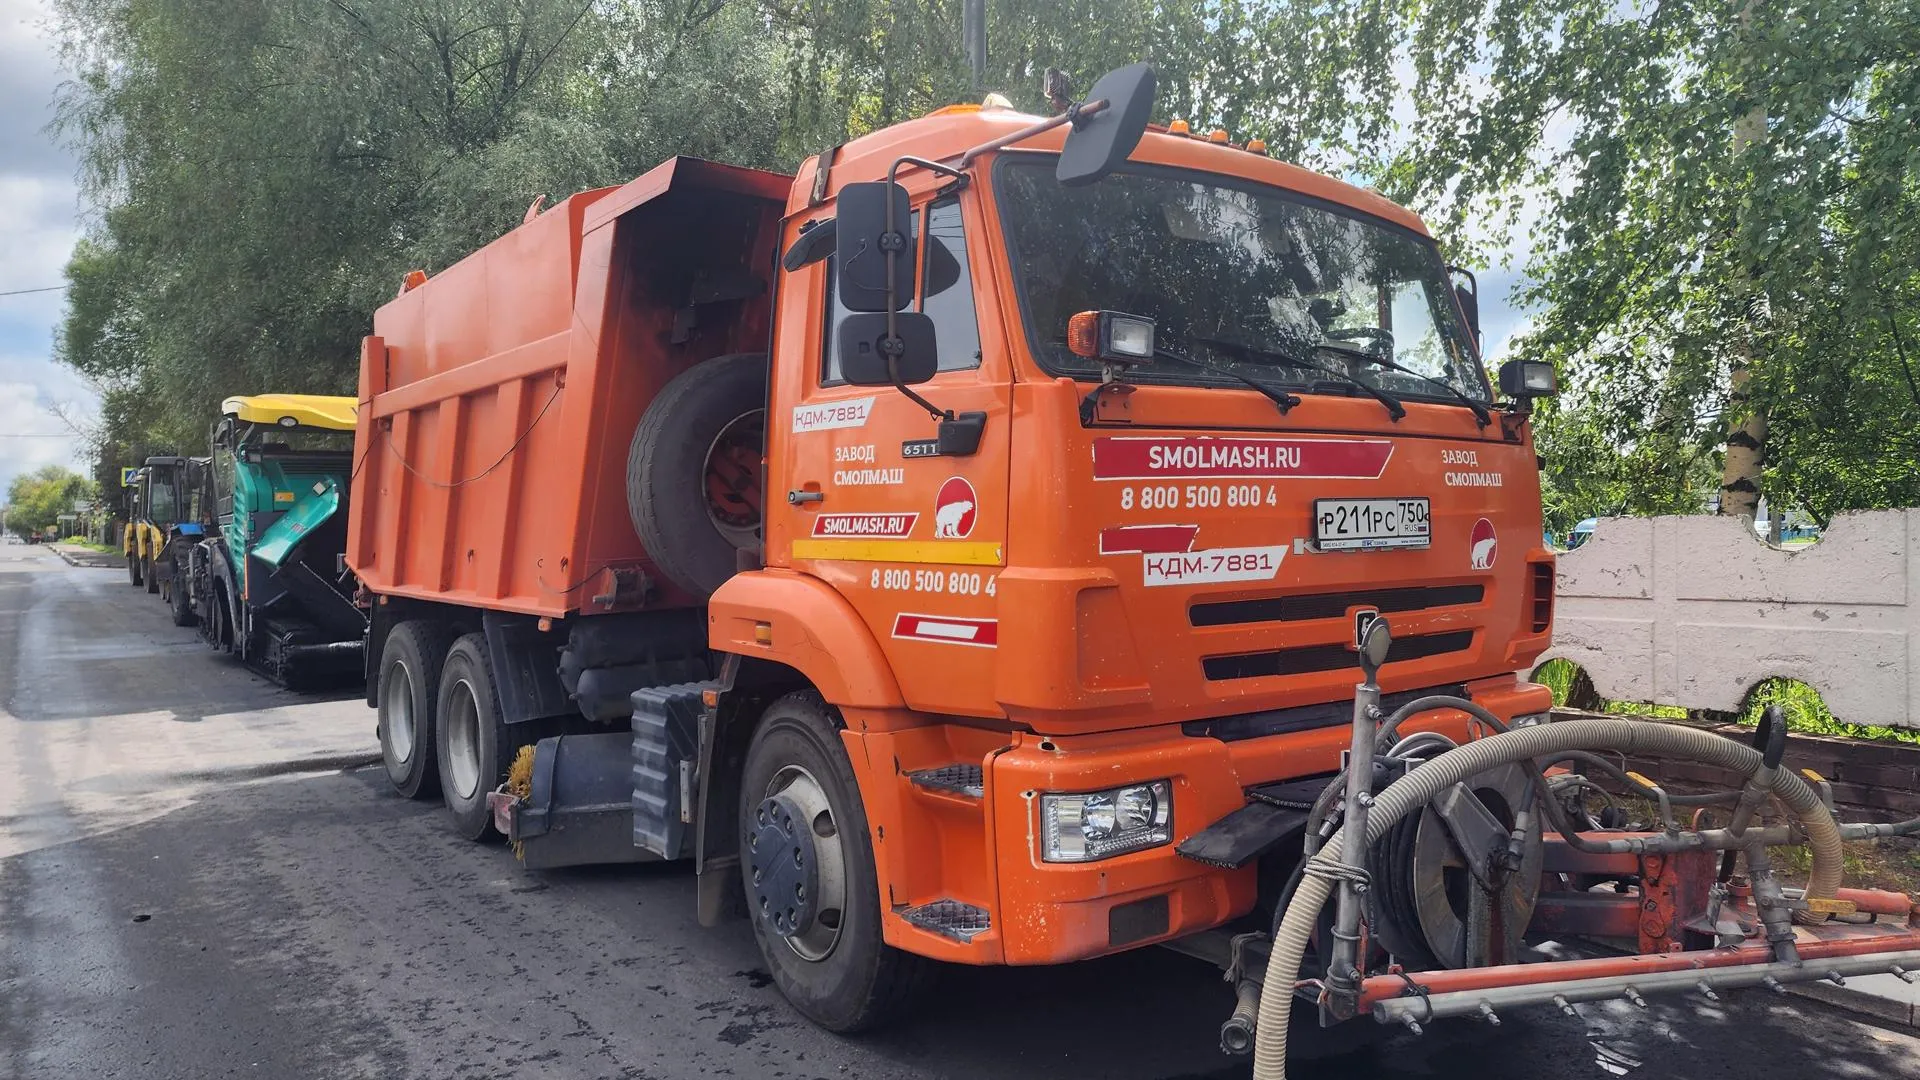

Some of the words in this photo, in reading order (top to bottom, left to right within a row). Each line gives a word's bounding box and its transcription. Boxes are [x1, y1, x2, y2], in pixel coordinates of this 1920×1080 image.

[795, 405, 866, 428] КДМ-7881
[835, 444, 876, 464] ЗАВОД
[1149, 446, 1301, 468] SMOLMASH.RU
[1441, 449, 1478, 467] ЗАВОД
[834, 468, 904, 486] СМОЛМАШ
[1444, 471, 1502, 487] СМОЛМАШ
[1121, 486, 1134, 510] 8
[1140, 486, 1179, 509] 800
[1185, 485, 1221, 508] 500
[1227, 485, 1261, 507] 800
[1266, 484, 1277, 506] 4
[823, 516, 906, 534] SMOLMASH.RU
[1324, 504, 1396, 535] Р211РС
[1398, 502, 1424, 524] 750
[1404, 524, 1418, 532] RUS
[1147, 553, 1274, 579] КДМ-7881
[871, 568, 880, 589] 8
[883, 568, 911, 591] 800
[914, 570, 944, 593] 500
[949, 572, 981, 596] 800
[984, 574, 997, 597] 4
